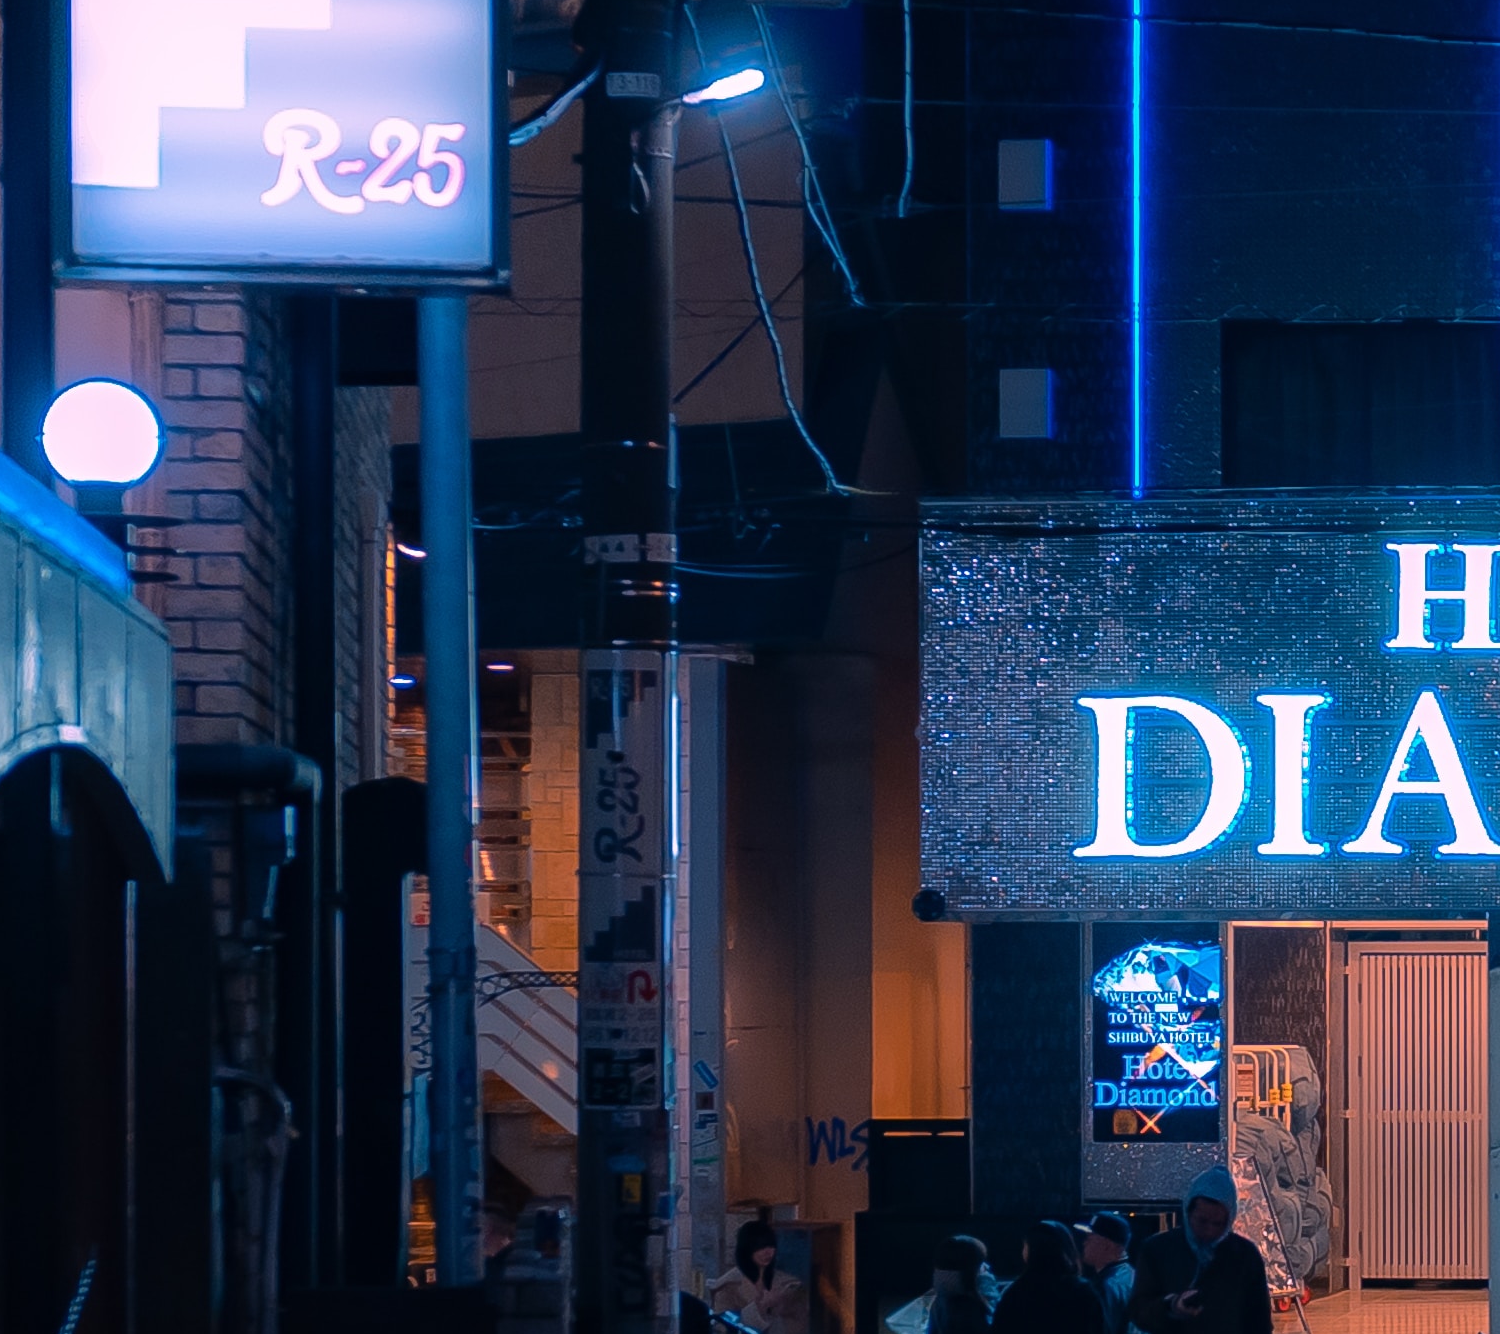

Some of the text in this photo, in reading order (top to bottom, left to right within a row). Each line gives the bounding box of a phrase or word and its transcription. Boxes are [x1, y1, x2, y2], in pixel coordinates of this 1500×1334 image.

[260, 108, 466, 214] R-25
[1109, 992, 1178, 1004] WELCOME
[1109, 1012, 1190, 1024] TO THE NEW
[1108, 1032, 1213, 1044] SHIBUYA HOTEL
[1094, 1080, 1219, 1107] Diamond
